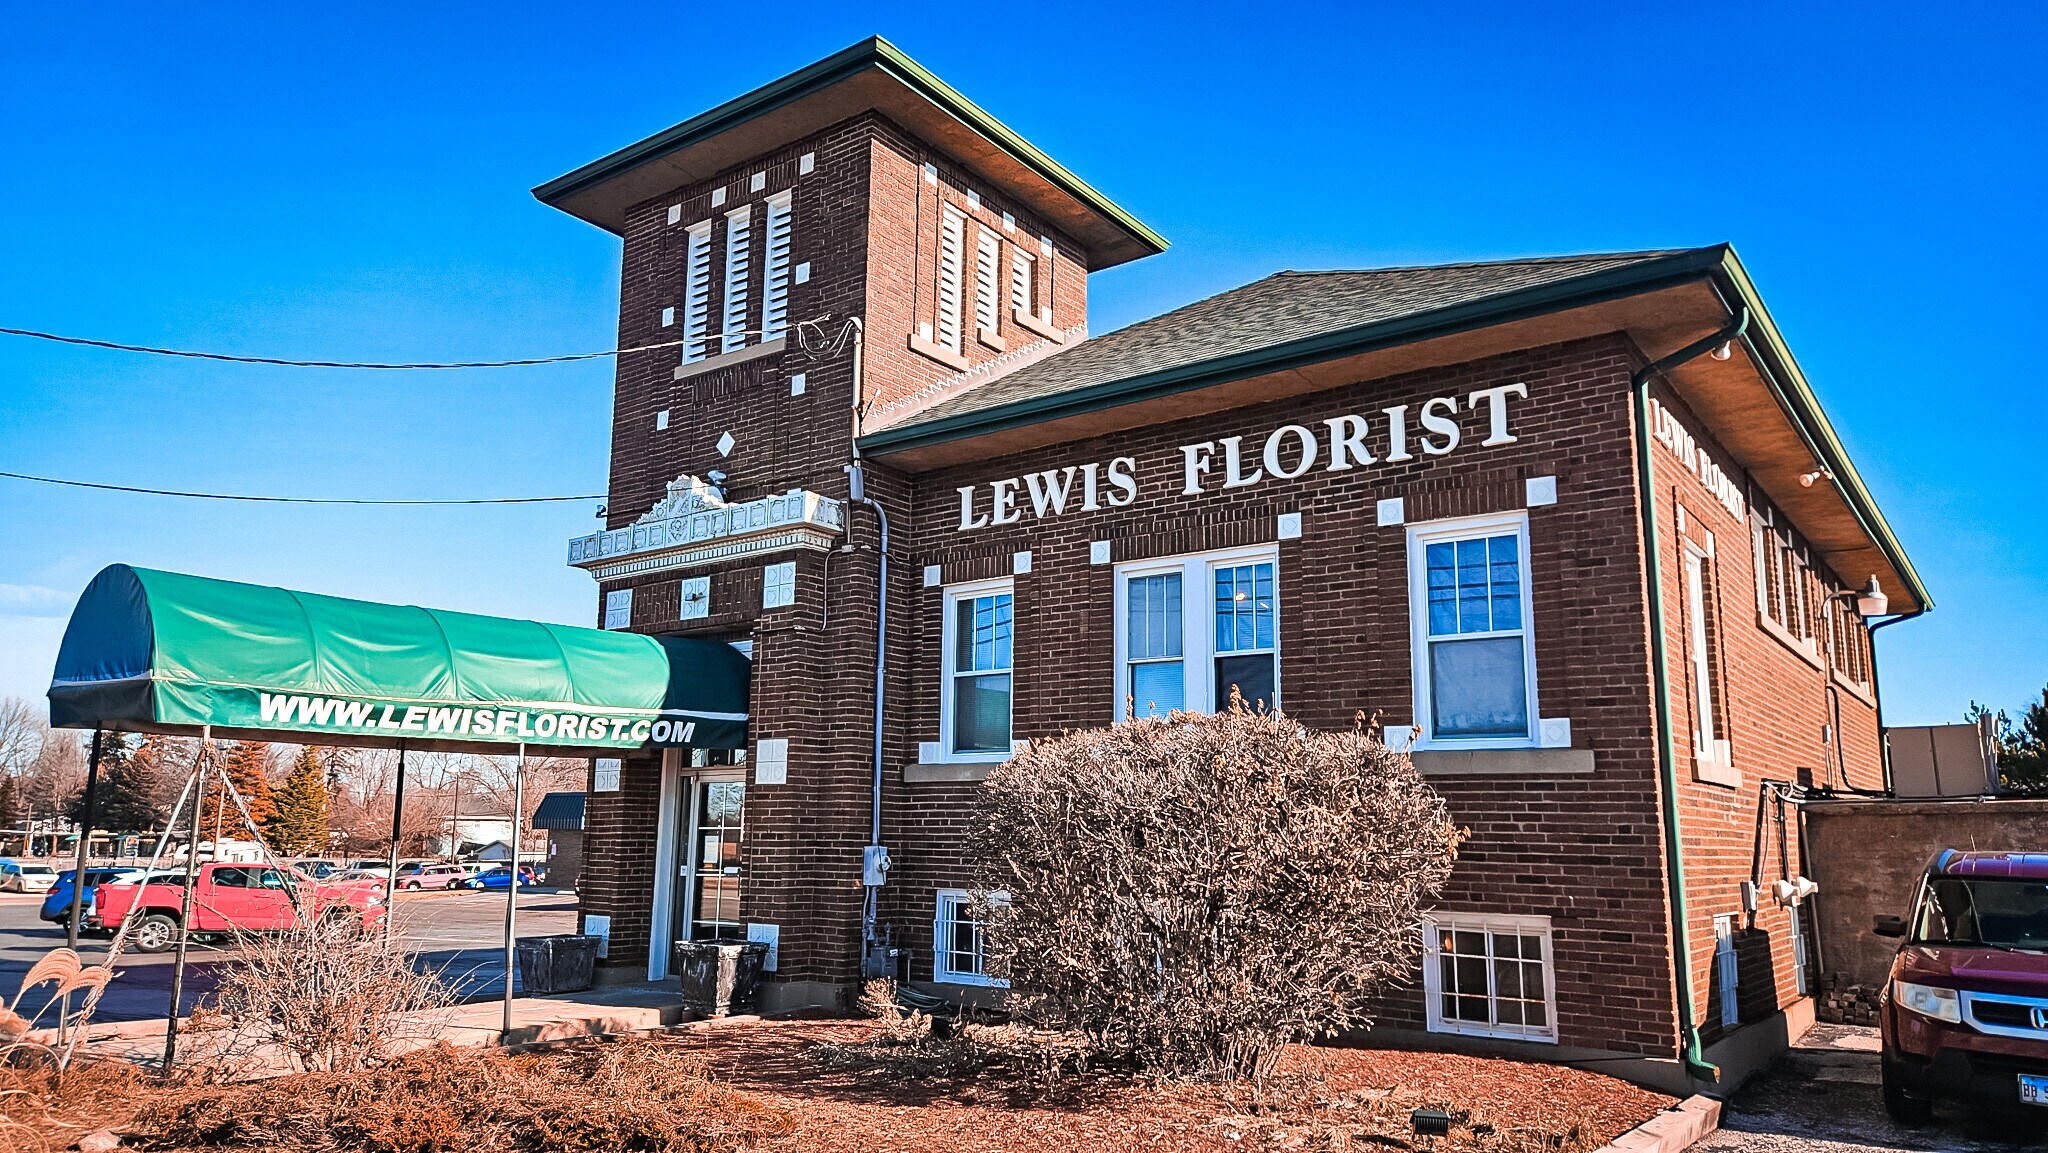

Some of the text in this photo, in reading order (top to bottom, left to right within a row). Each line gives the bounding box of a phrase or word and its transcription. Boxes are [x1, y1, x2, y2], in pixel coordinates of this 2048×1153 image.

[957, 382, 1528, 531] LEWIS FLORIST
[1649, 398, 1744, 523] LEWIS FLORIST
[259, 692, 696, 744] WWW.LEWISFLORIST.COM
